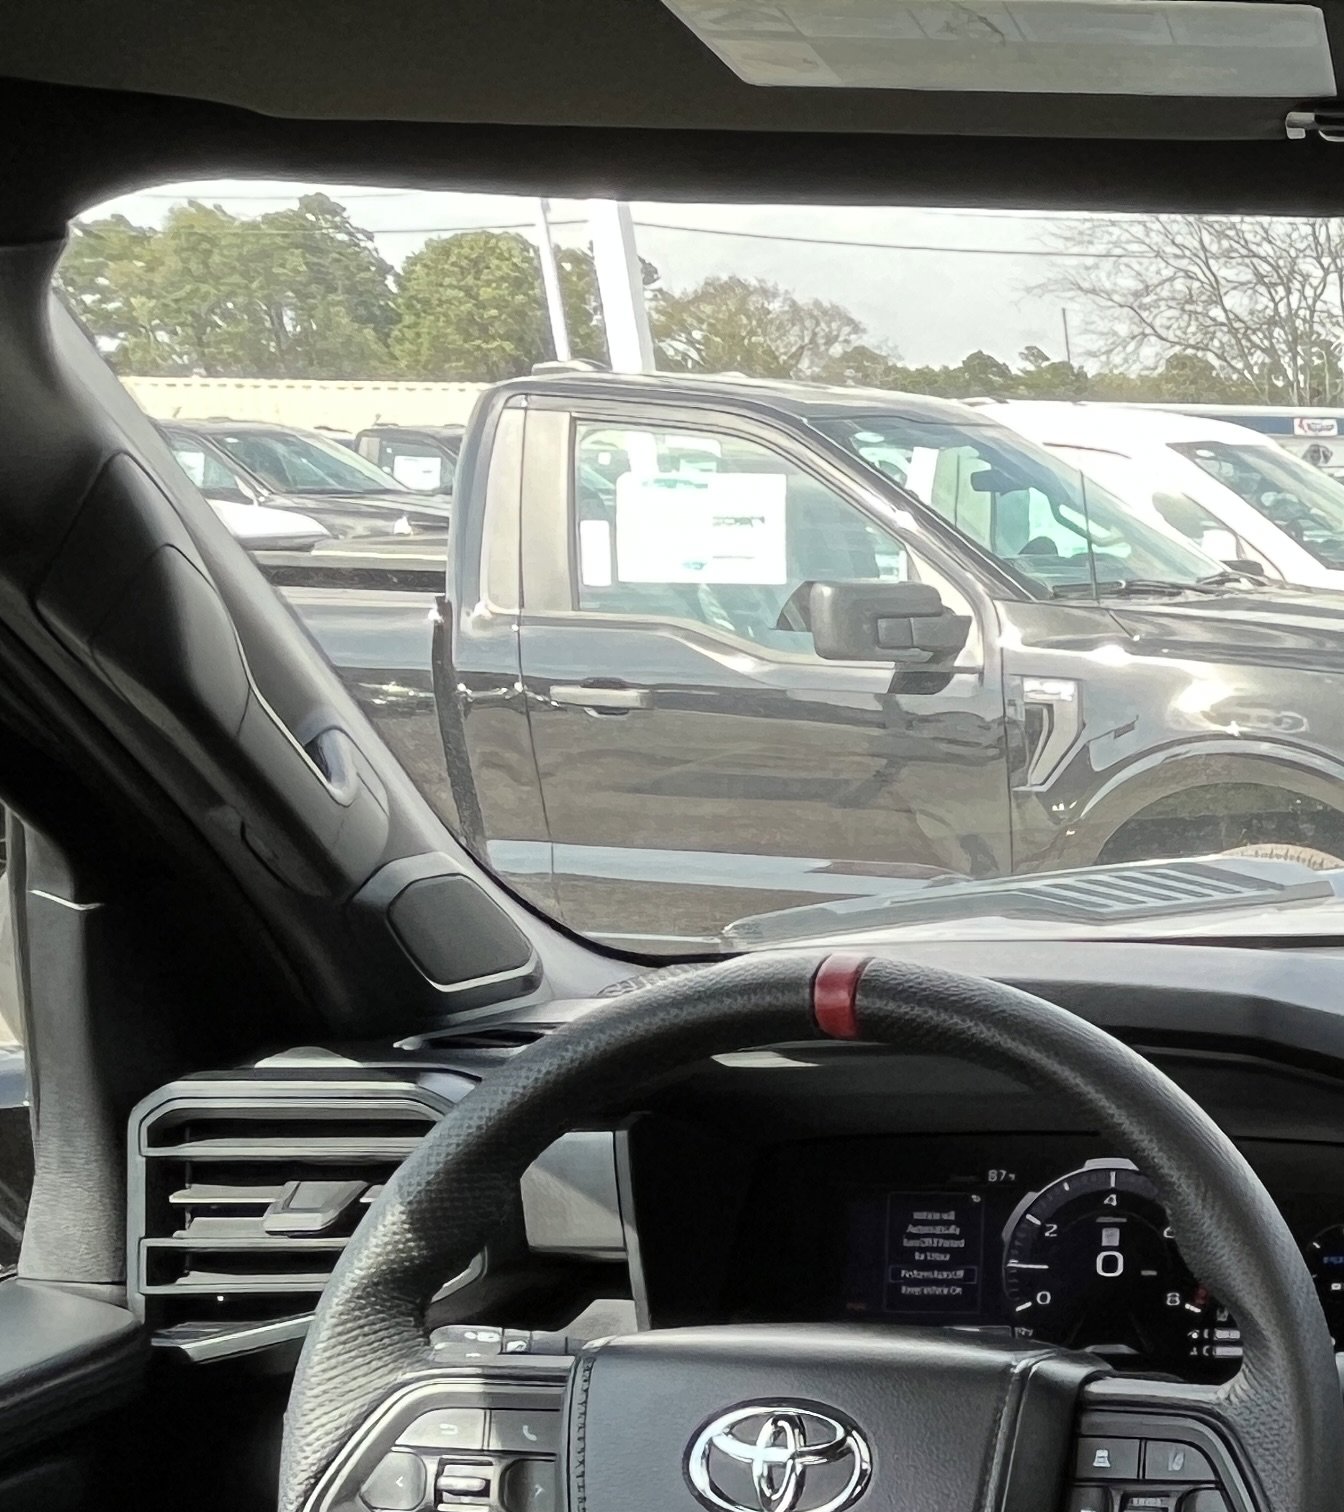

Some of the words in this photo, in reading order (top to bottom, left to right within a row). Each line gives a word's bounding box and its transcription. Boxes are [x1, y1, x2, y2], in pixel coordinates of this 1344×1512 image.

[1103, 1194, 1118, 1206] 4
[1044, 1224, 1058, 1237] 2
[1096, 1251, 1124, 1277] 0
[1036, 1291, 1051, 1305] 0
[1166, 1293, 1181, 1306] 8
